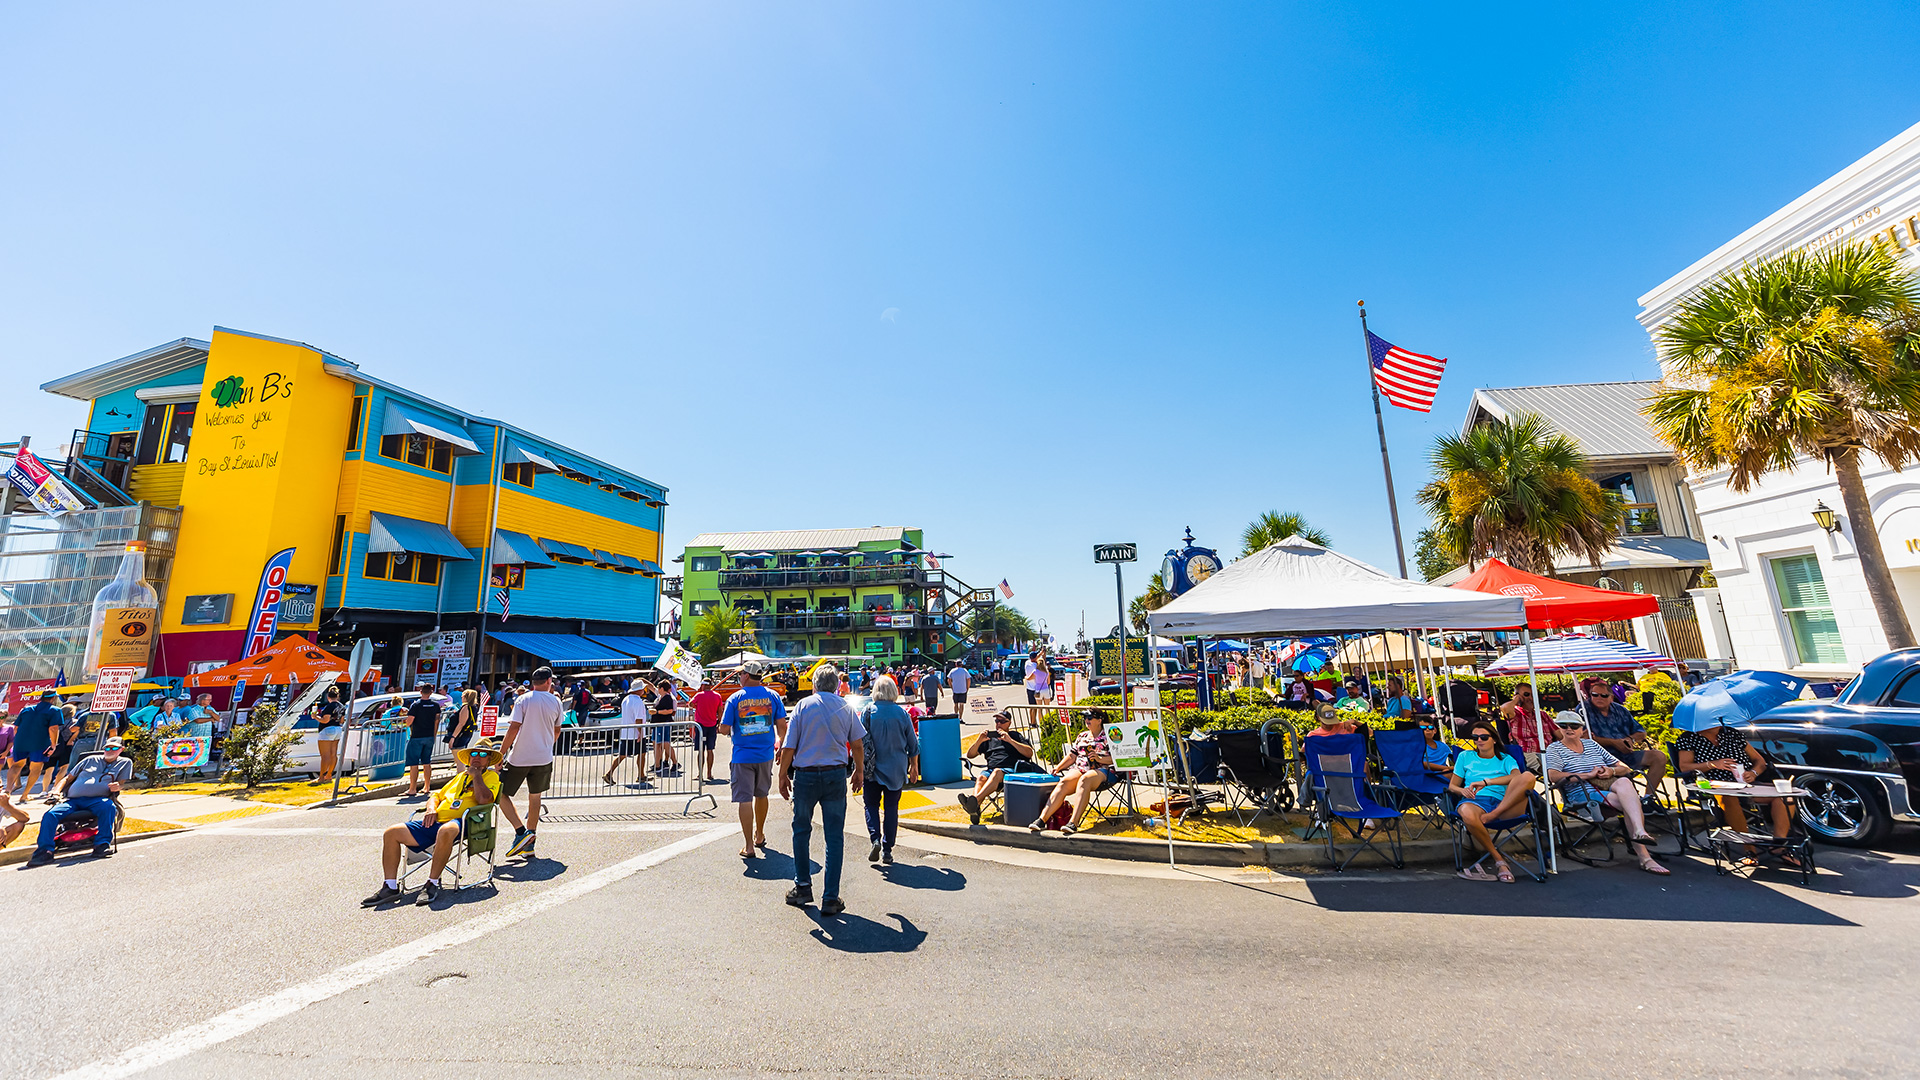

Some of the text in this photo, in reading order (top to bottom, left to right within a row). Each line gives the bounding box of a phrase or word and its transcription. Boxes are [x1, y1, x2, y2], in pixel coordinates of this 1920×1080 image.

[1851, 206, 1881, 228] 1899
[215, 372, 293, 406] Dan B's
[205, 411, 272, 430] Welcomes you
[231, 435, 246, 450] To
[198, 458, 217, 476] Bay
[1100, 549, 1131, 560] MAIN
[118, 609, 152, 620] Tito's
[247, 565, 287, 657] OPEN
[283, 599, 316, 621] Lite
[18, 685, 33, 693] This
